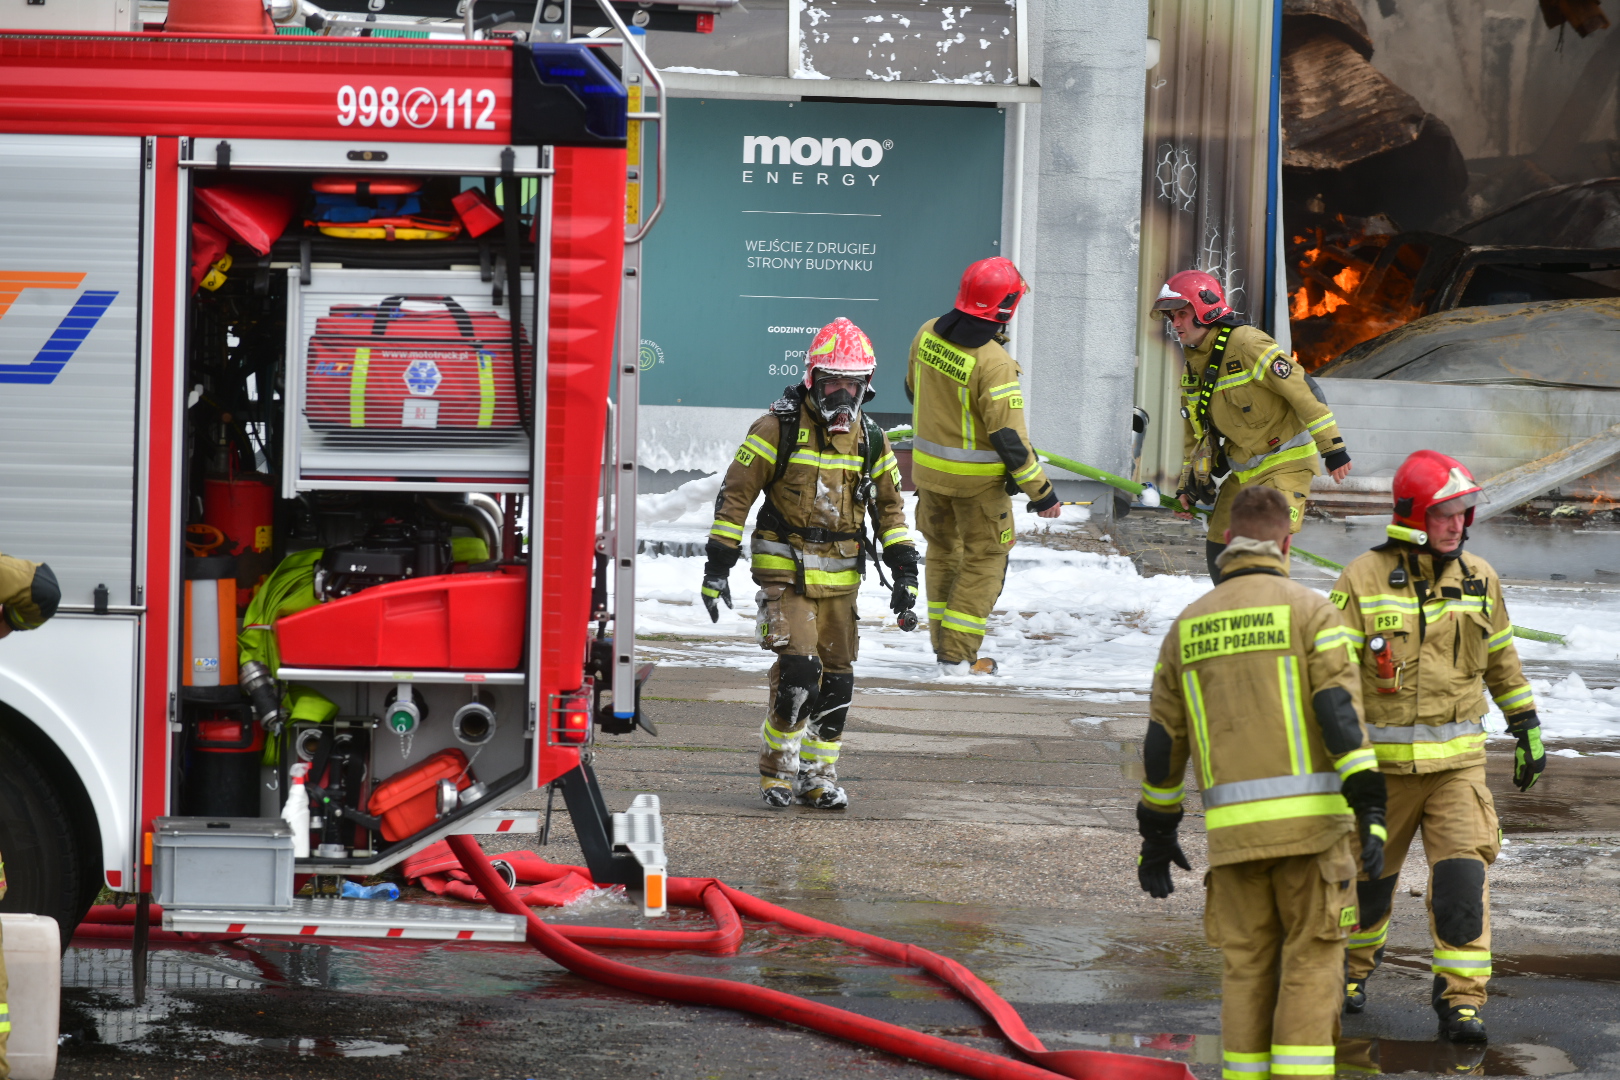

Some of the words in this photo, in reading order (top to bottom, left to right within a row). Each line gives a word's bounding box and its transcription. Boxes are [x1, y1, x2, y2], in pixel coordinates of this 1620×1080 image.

[337, 85, 399, 127] 998
[441, 88, 496, 130] 112
[742, 170, 880, 187] ENERGY
[745, 238, 803, 253] WEJŚCIE
[805, 241, 814, 253] Z
[817, 242, 876, 255] DRUGIEJ
[747, 256, 803, 269] STRONY
[805, 258, 873, 272] BUDYNKU
[767, 325, 805, 334] GODZINY
[923, 337, 966, 368] PAŃSTWOWA
[768, 363, 799, 376] 8:00
[735, 448, 751, 462] PSP
[1190, 612, 1274, 638] PAŃSTWOWA
[1377, 615, 1399, 628] PSP
[1183, 637, 1219, 659] STRAŻ
[1224, 630, 1286, 650] POŻARNA
